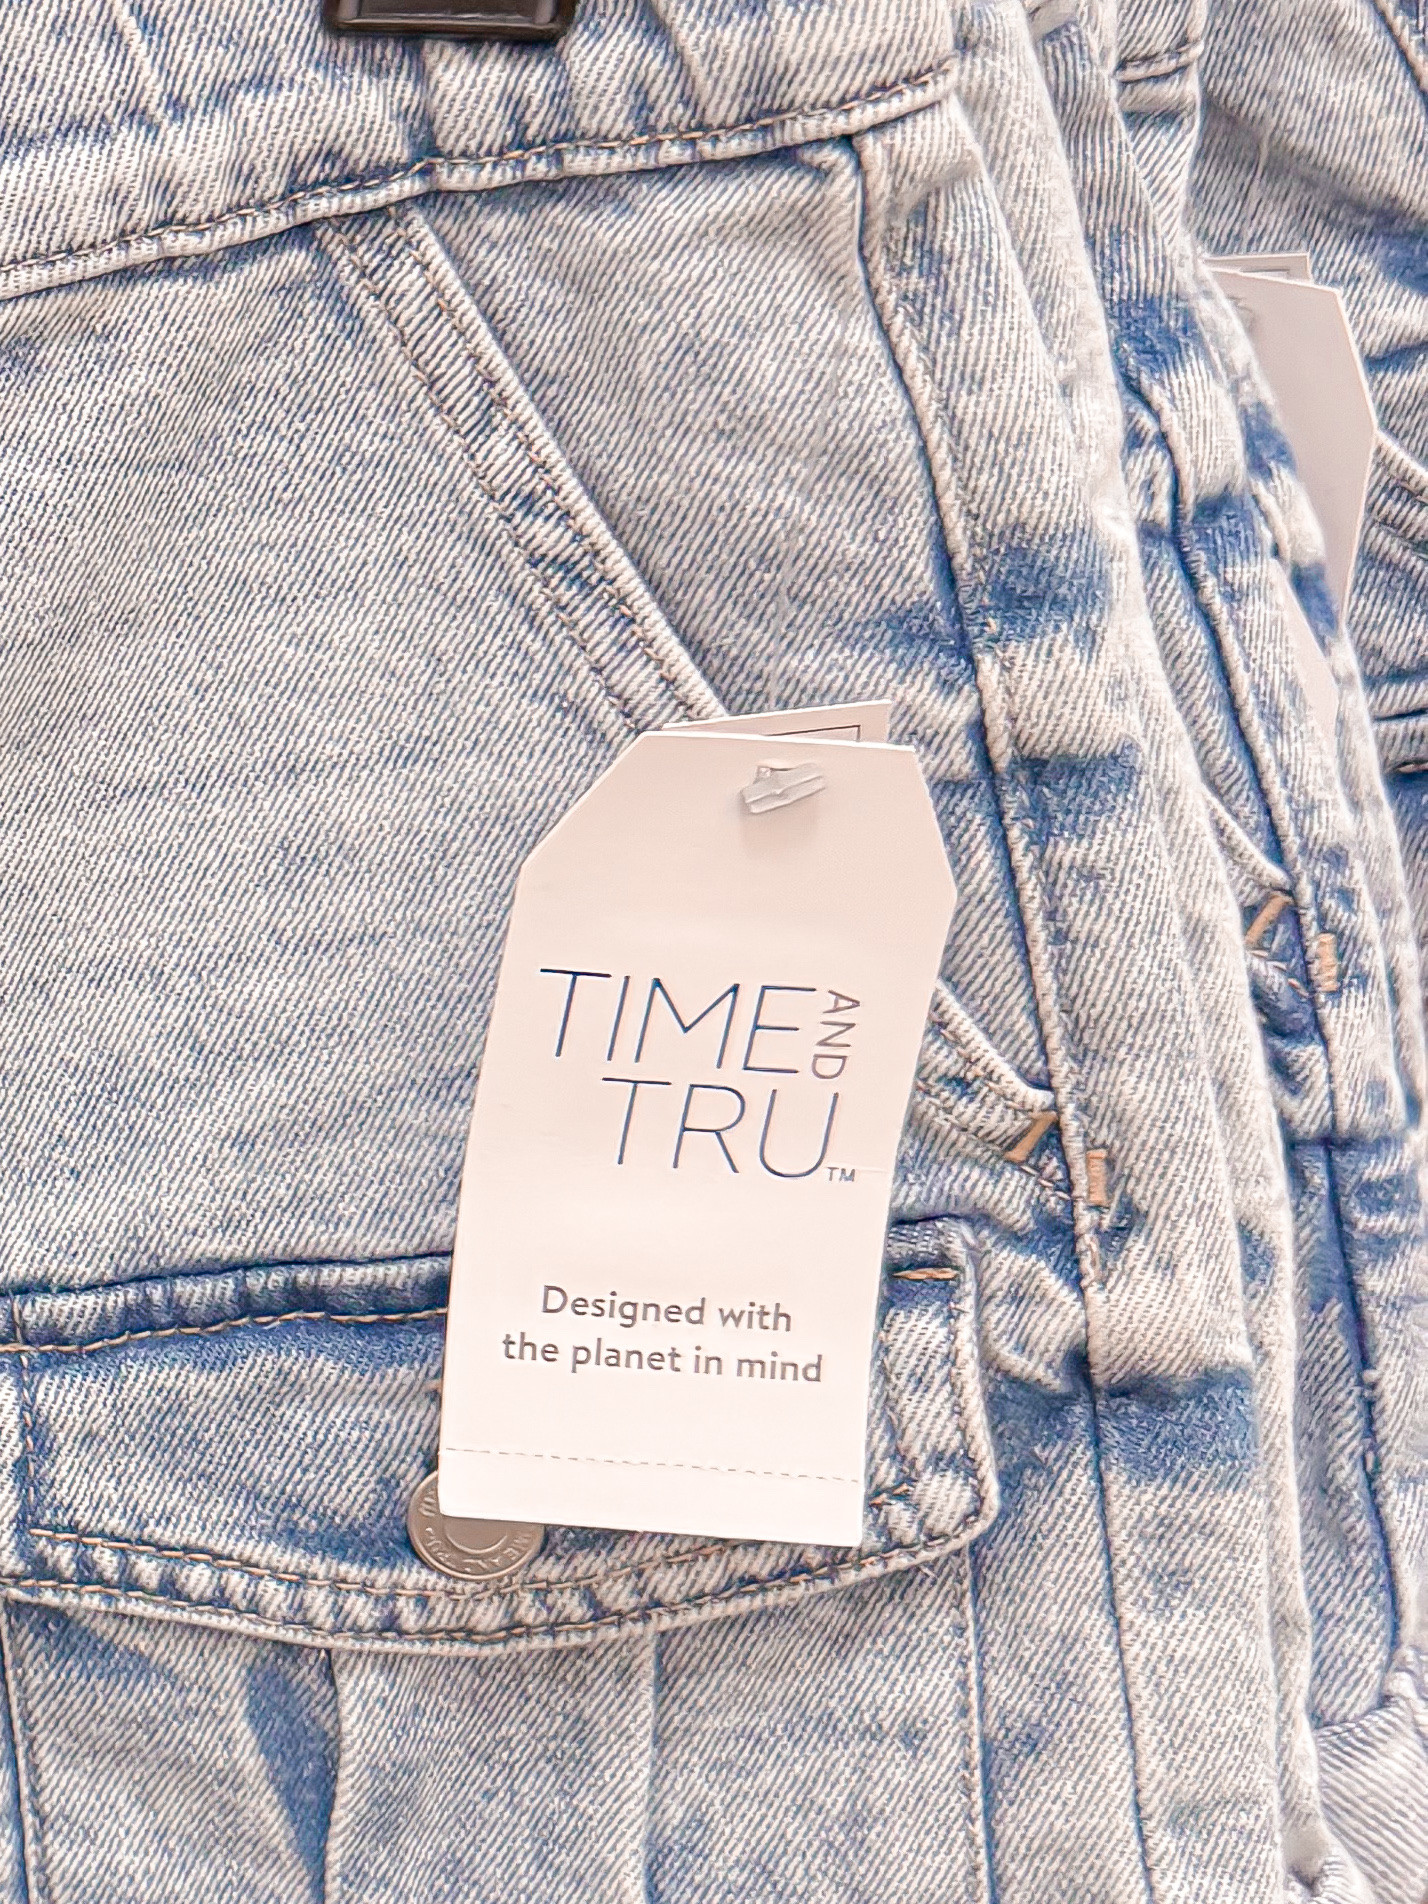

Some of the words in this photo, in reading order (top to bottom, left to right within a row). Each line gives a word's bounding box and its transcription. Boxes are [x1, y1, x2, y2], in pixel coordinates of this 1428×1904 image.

[540, 968, 817, 1074] TIME
[811, 989, 861, 1080] AND
[541, 1285, 706, 1327] Designed
[717, 1301, 792, 1333] with
[502, 1329, 561, 1365] the
[571, 1337, 682, 1374] planet
[694, 1345, 723, 1375] in
[736, 1350, 823, 1383] mind
